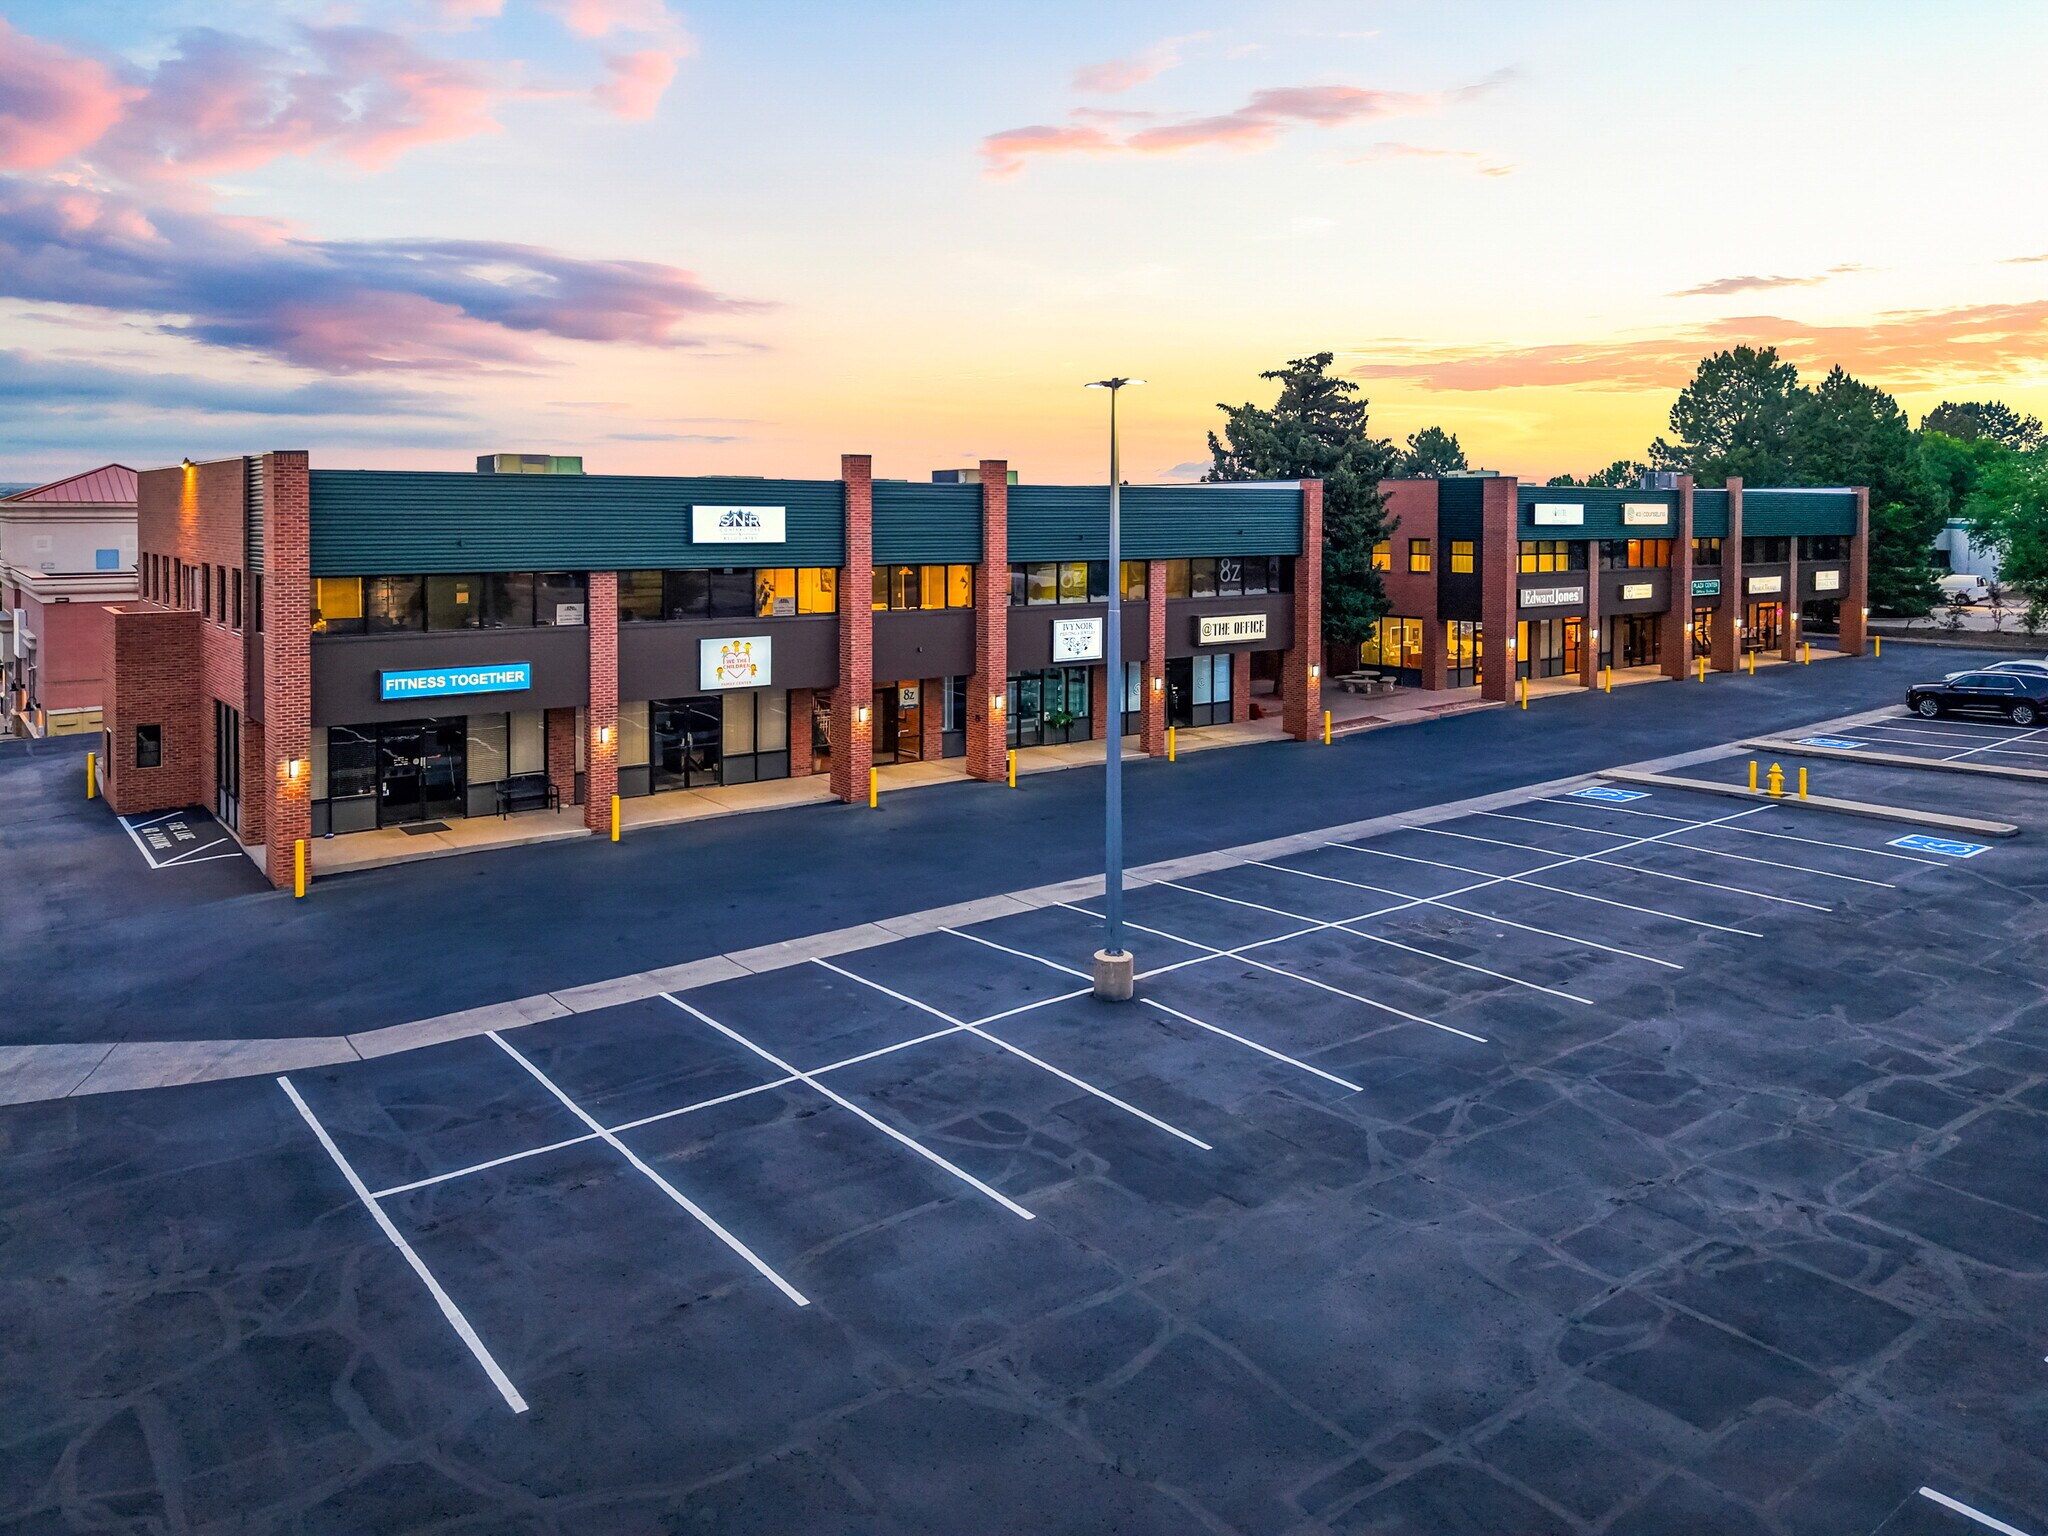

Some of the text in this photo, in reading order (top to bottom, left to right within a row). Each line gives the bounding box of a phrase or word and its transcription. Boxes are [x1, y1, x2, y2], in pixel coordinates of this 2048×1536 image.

[1075, 622, 1093, 630] NOIR
[1234, 620, 1264, 634] OFFICE
[385, 671, 525, 691] FITNESS TOGETHER
